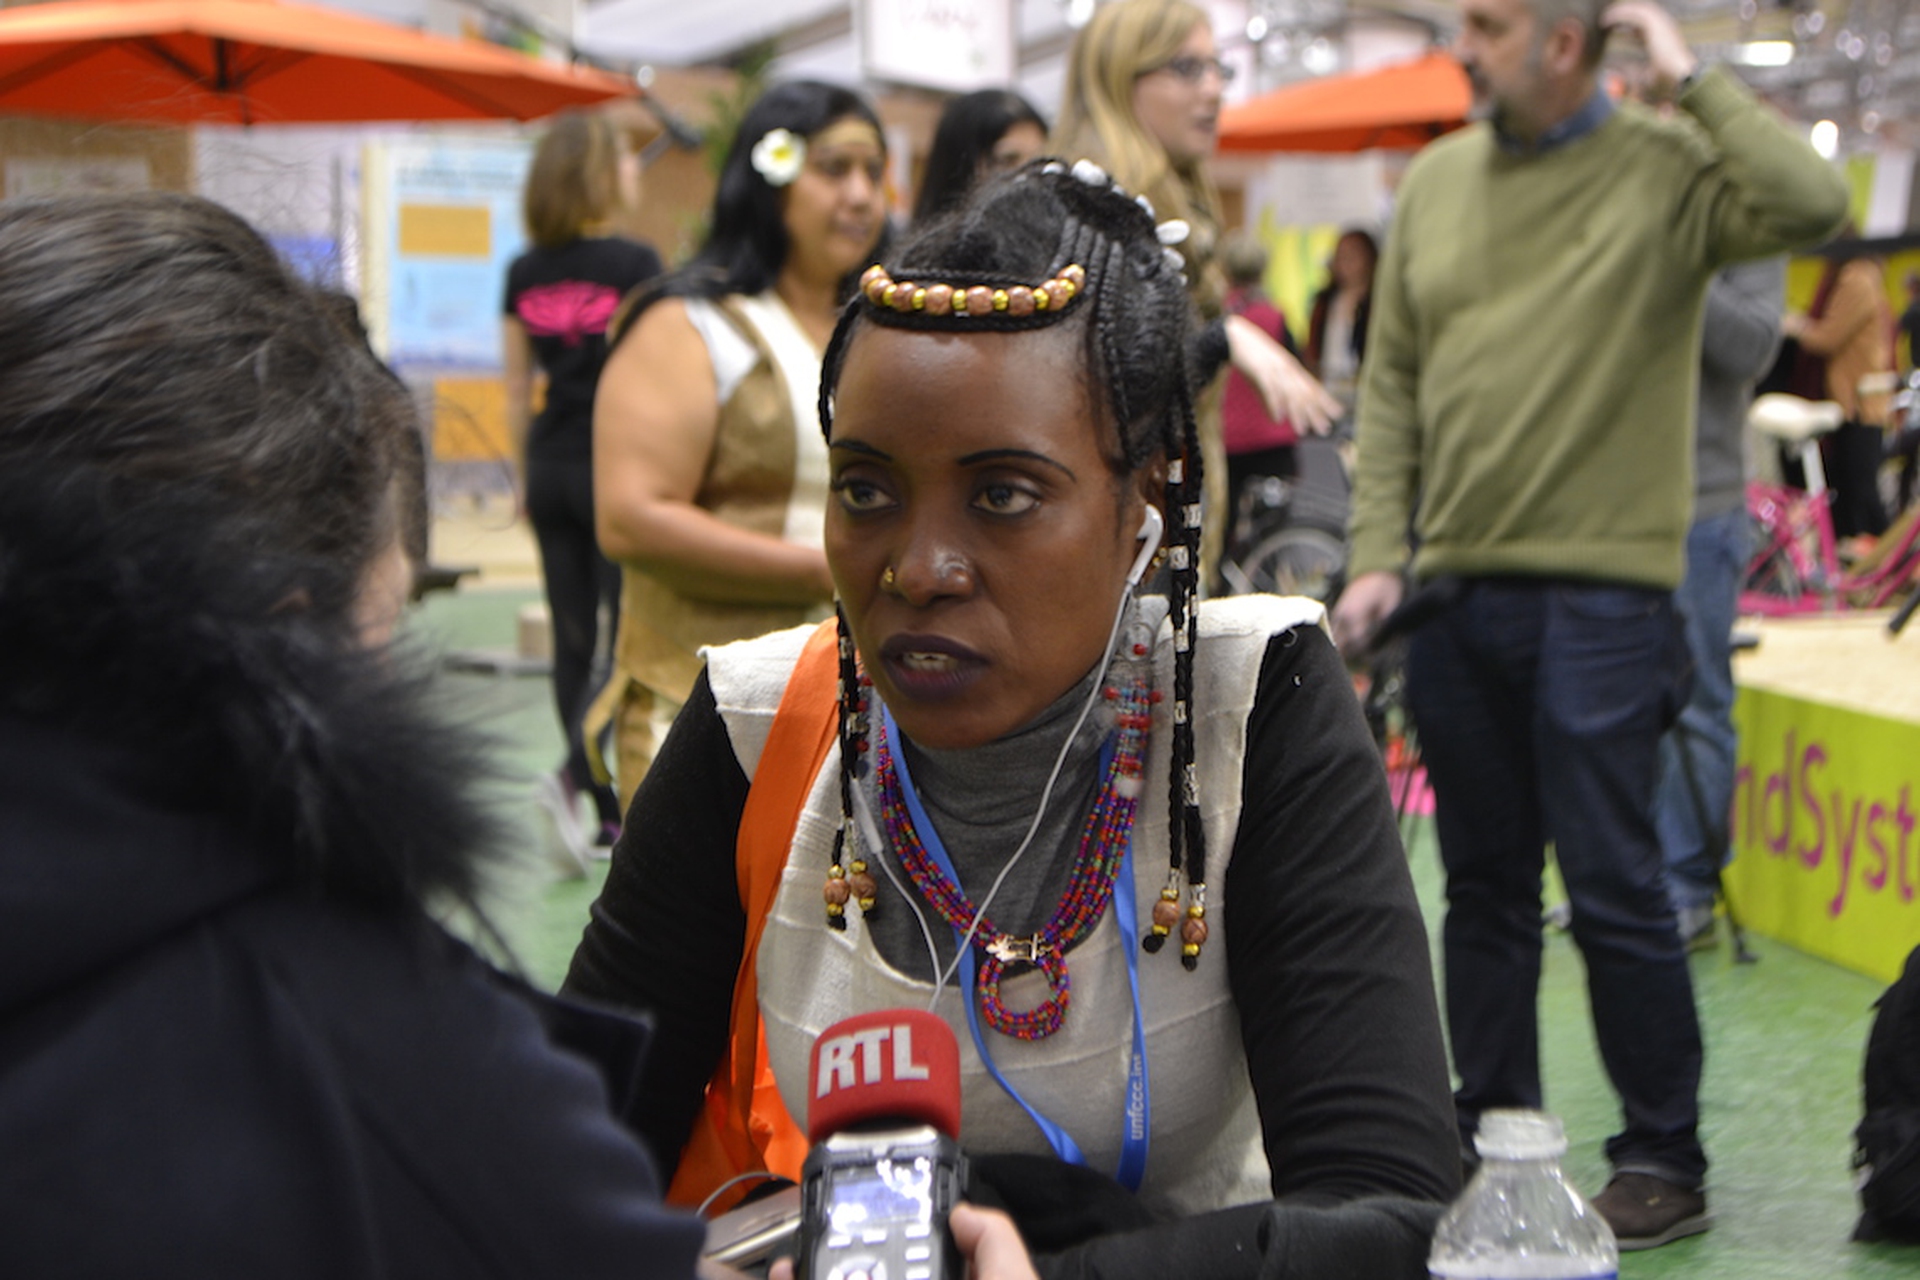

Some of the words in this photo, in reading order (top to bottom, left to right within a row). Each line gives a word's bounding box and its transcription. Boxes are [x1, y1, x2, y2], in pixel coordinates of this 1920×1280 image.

[1728, 726, 1920, 919] ndSyst
[817, 1024, 929, 1099] RTL
[1127, 1053, 1144, 1141] unfccc.int
